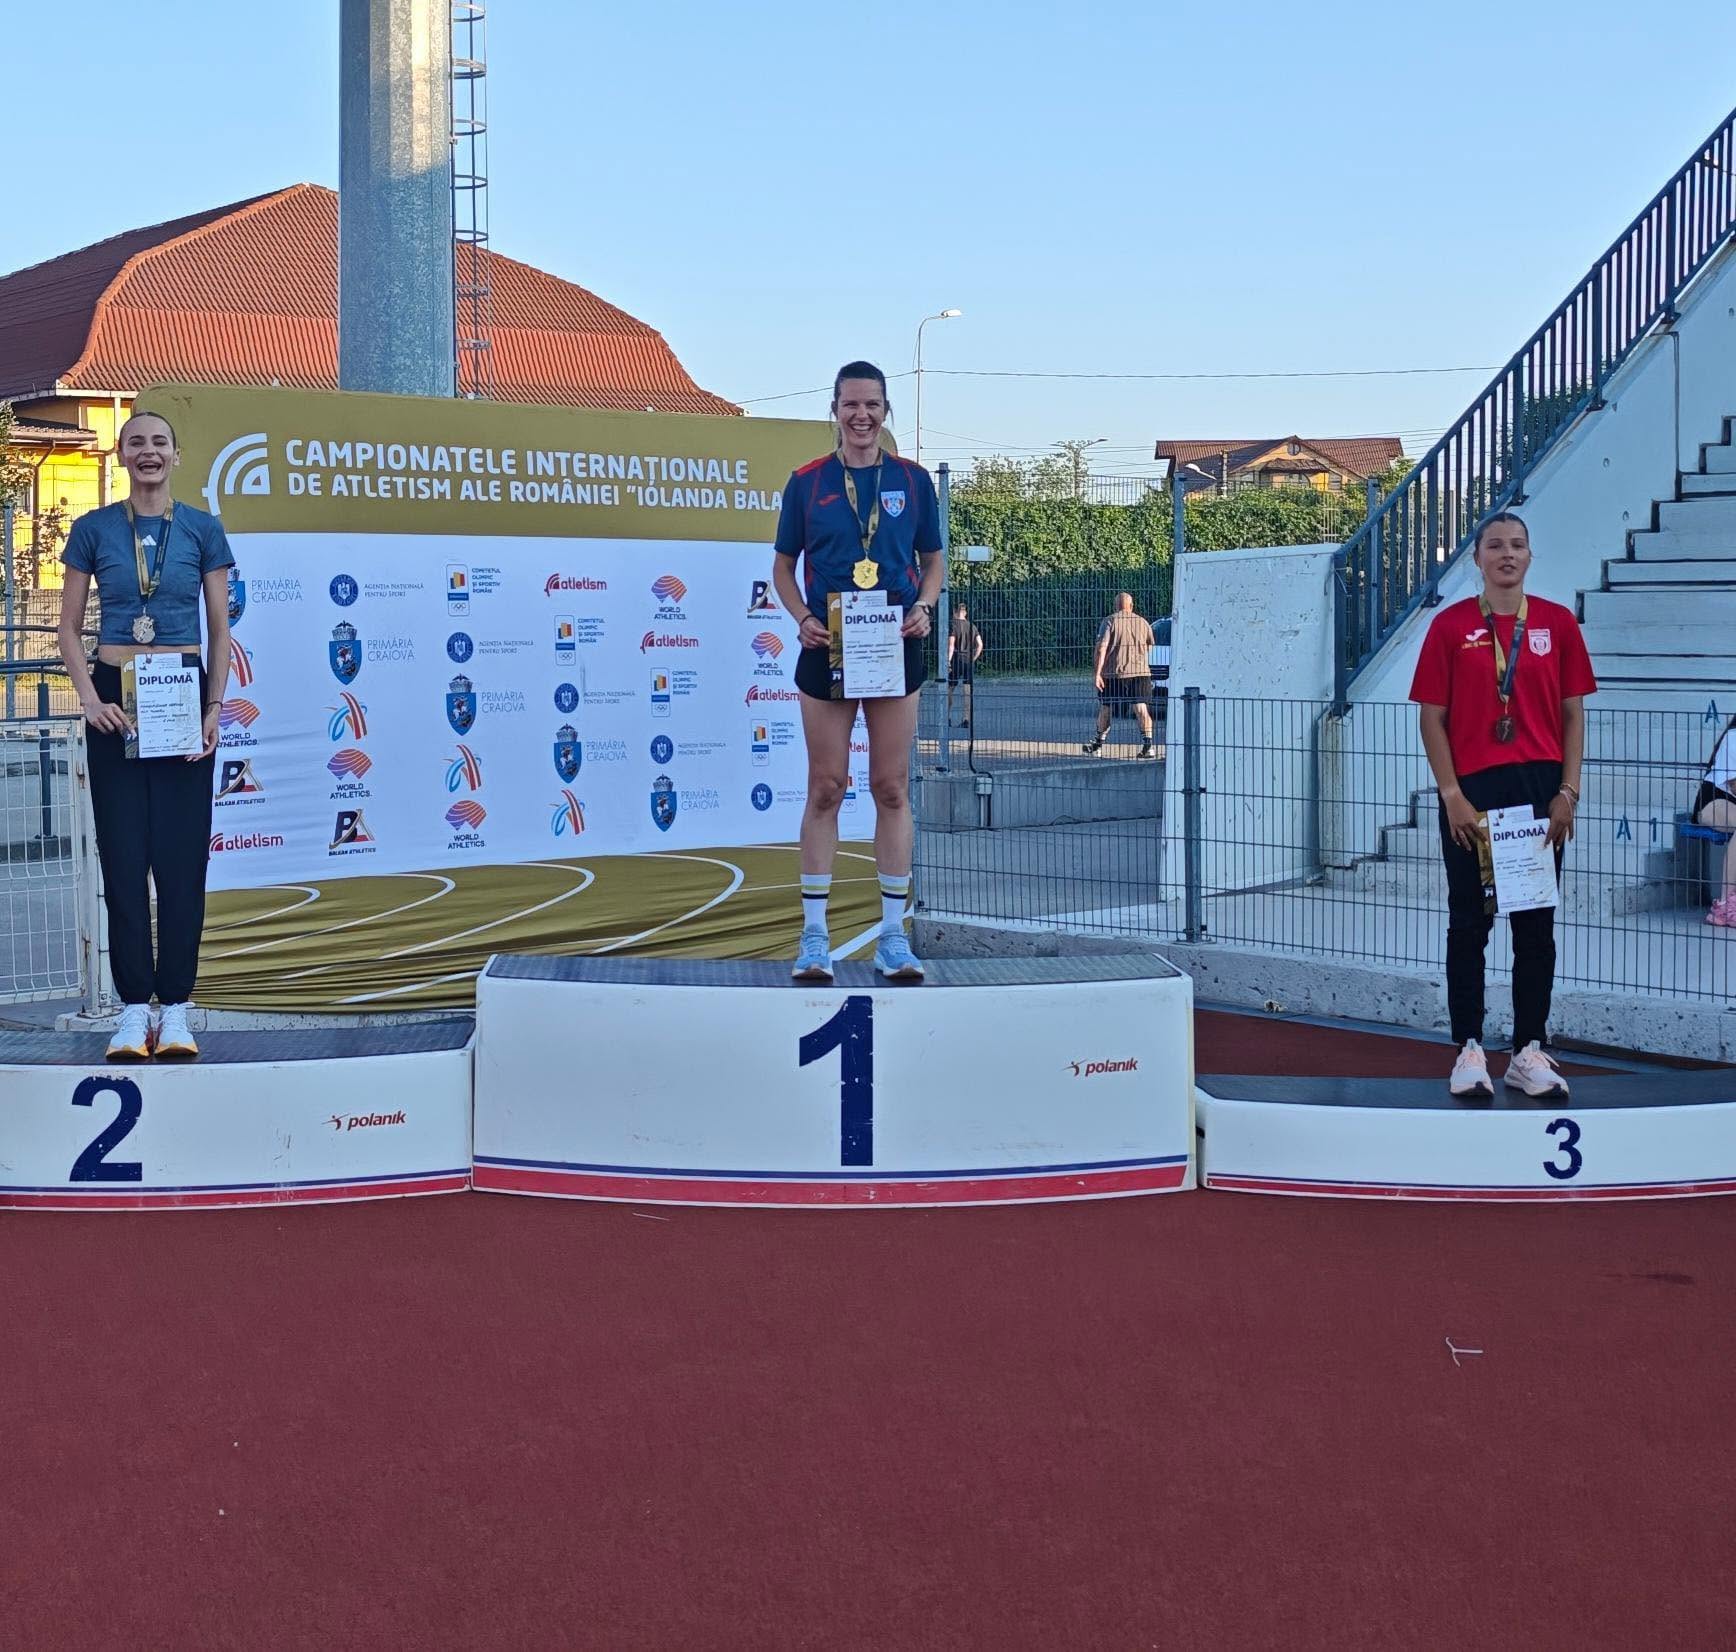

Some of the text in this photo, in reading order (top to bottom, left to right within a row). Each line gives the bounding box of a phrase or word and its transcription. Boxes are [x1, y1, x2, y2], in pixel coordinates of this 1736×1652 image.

[286, 439, 749, 485] CAMPIONATELE INTERNAȚIONALE
[288, 472, 322, 496] DE
[331, 474, 451, 500] ATLETISM
[460, 479, 502, 502] ALE
[509, 478, 620, 506] ROMÂNIEI
[560, 576, 608, 591] atletism
[251, 590, 303, 603] CRAIOVA
[845, 610, 897, 625] DIPLOMĂ
[655, 634, 699, 648] atletism
[367, 650, 415, 662] CRAIOVA
[138, 671, 194, 686] DIPLOMĂ
[759, 687, 800, 701] atletism
[1704, 699, 1720, 724] A
[221, 732, 251, 741] WORLD
[850, 741, 868, 752] tleti
[336, 783, 364, 791] WORLD
[1493, 824, 1546, 842] DIPLOMĂ
[1616, 815, 1632, 841] A
[225, 833, 284, 850] atletism
[453, 834, 480, 842] WORLD
[1085, 1057, 1138, 1077] polanik
[799, 995, 874, 1167] 1
[69, 1075, 143, 1182] 2
[347, 1110, 407, 1132] polanik
[1543, 1118, 1583, 1180] 3
